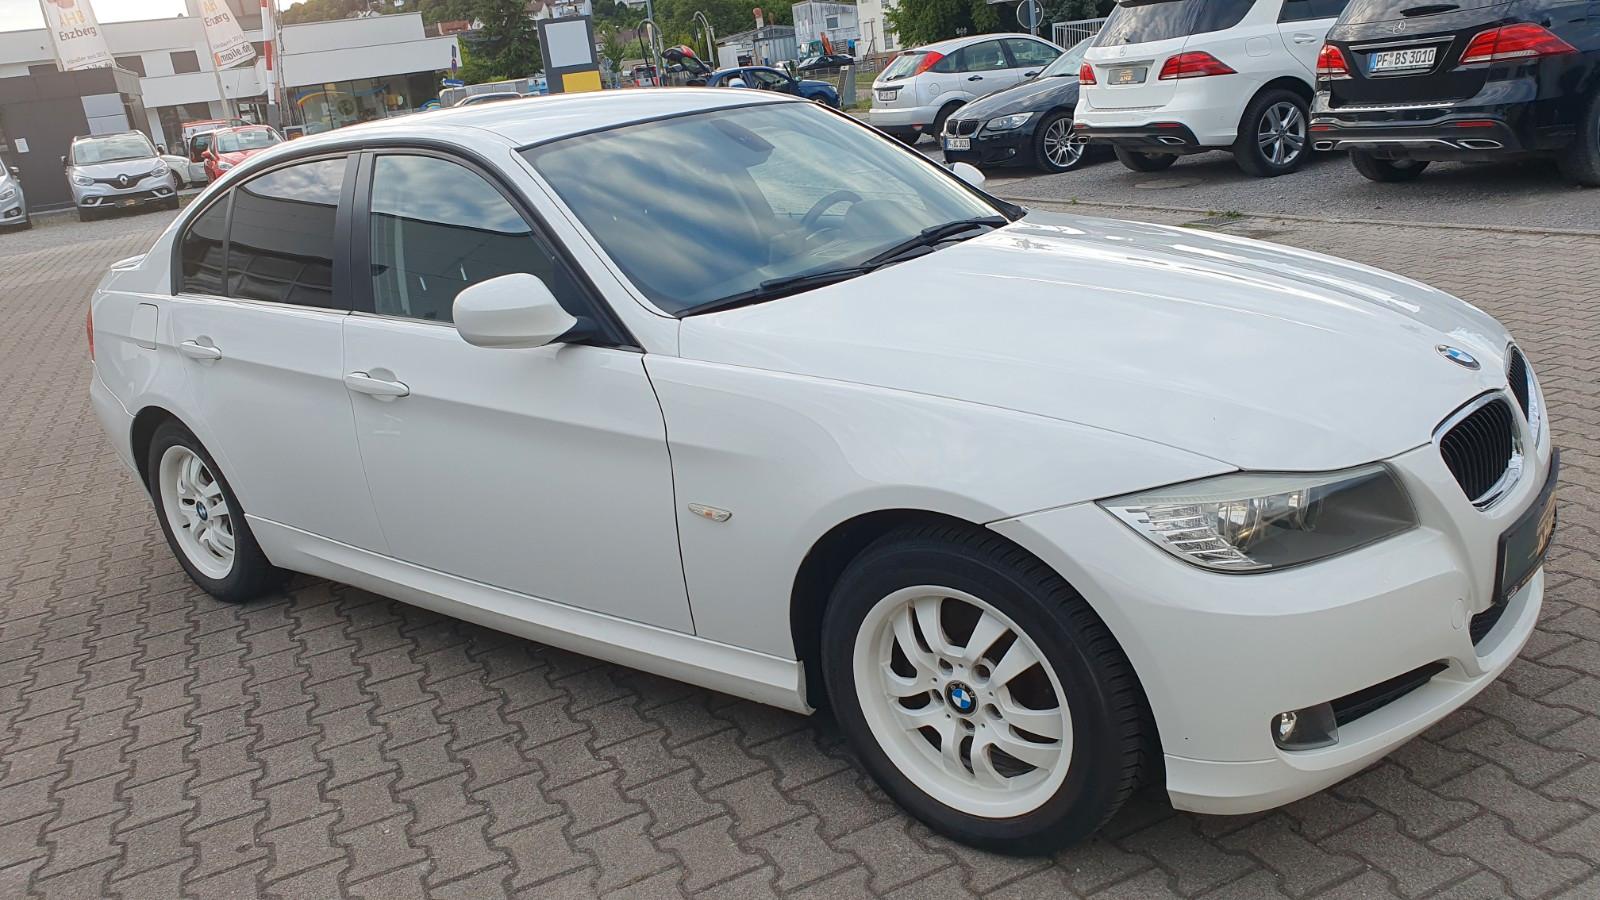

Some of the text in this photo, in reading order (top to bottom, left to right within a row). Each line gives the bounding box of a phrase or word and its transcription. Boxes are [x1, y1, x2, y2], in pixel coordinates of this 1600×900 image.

[59, 26, 97, 41] Enzberg
[1376, 49, 1435, 67] PF BS 3010
